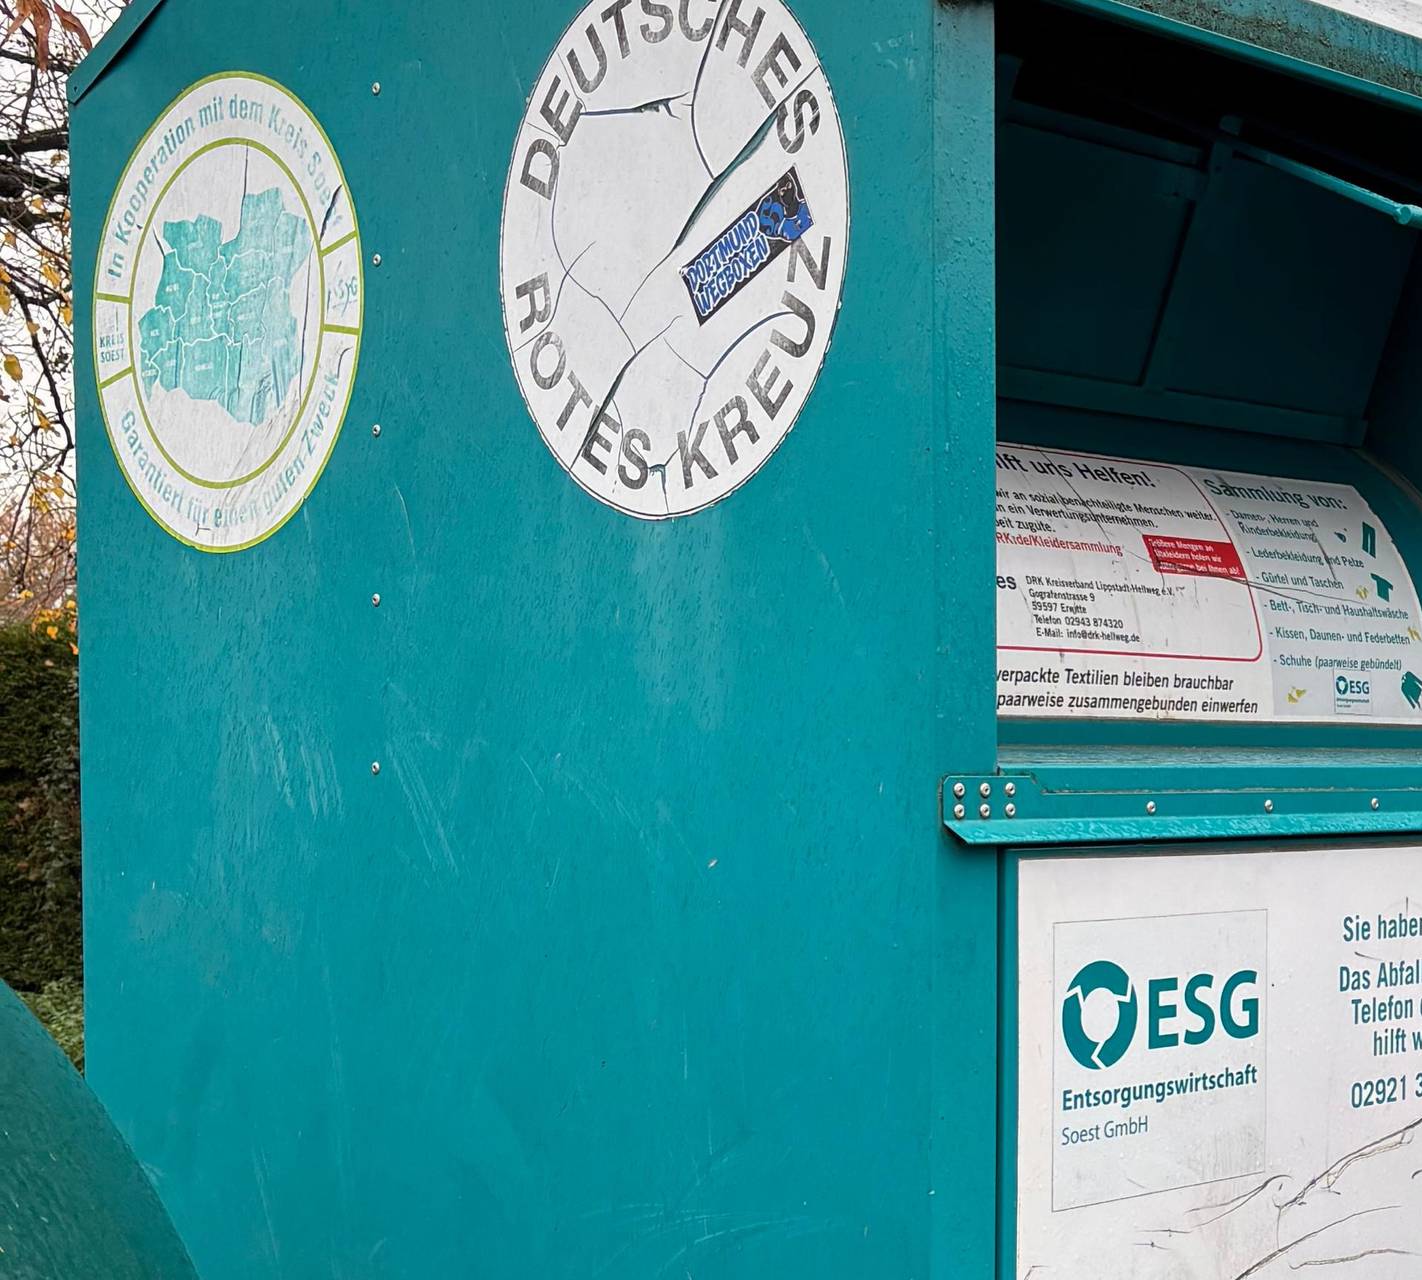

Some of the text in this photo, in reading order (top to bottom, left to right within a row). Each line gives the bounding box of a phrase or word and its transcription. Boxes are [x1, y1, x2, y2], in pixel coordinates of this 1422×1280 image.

[198, 96, 224, 130] mit
[229, 94, 263, 125] dem
[520, 0, 821, 200] DEUTSCHES
[268, 104, 309, 160] Kreis
[115, 116, 196, 246] Kooperation
[686, 211, 760, 293] DORTMUND
[107, 253, 125, 279] In
[694, 234, 771, 317] WEGBOXEN
[99, 334, 125, 348] KREIS
[100, 350, 125, 364] SOEST
[515, 235, 832, 492] ROTES KREUZ
[121, 410, 184, 514] Garantiert
[187, 493, 209, 528] für
[302, 368, 339, 457] Zweck
[996, 452, 1156, 488] lft uns Helfen!
[1013, 490, 1028, 502] an
[1029, 490, 1059, 505] sozial
[1061, 493, 1133, 513] benachteiligte
[1134, 501, 1185, 519] Menschen
[1204, 479, 1349, 510] Sammlung von:
[1007, 504, 1026, 515] ein
[1028, 504, 1159, 529] Verwertungsunternehmen.
[1016, 520, 1057, 534] zugute.
[1272, 512, 1300, 526] Herren
[1250, 547, 1325, 567] Lederbekleidung
[1343, 557, 1365, 569] Pelze
[1025, 575, 1044, 587] DRK
[1046, 576, 1095, 591] Kreisverband
[1095, 580, 1160, 597] Lippstadt-Hellweg
[1261, 570, 1344, 590] Gürtel und Taschen
[1032, 601, 1058, 612] 59597
[1089, 592, 1096, 602] 9
[1034, 614, 1124, 629] Telefon 02943 874320
[1323, 604, 1341, 616] und
[1343, 603, 1409, 620] Haushaltswäsche
[1036, 627, 1140, 643] E-Mail: info@drk-hellweg.de
[1275, 627, 1411, 645] Kissen, Daunen- und Federbetten
[1279, 654, 1402, 671] Schuhe (paarweise gebündelt)
[1064, 668, 1120, 686] Textilien
[1123, 670, 1169, 688] bleiben
[1174, 674, 1235, 691] brauchbar
[1349, 680, 1370, 695] ESG
[997, 692, 1259, 714] paarweise zusammengebunden einwerfen
[1343, 915, 1371, 942] Sie
[1339, 965, 1371, 992] Das
[1148, 969, 1259, 1050] ESG
[1351, 995, 1414, 1025] Telefon
[1373, 1028, 1406, 1056] hilft
[1062, 1063, 1258, 1111] Entsorgungswirtschaft
[1351, 1075, 1406, 1108] 02921
[1061, 1115, 1149, 1146] Soest GmbH
